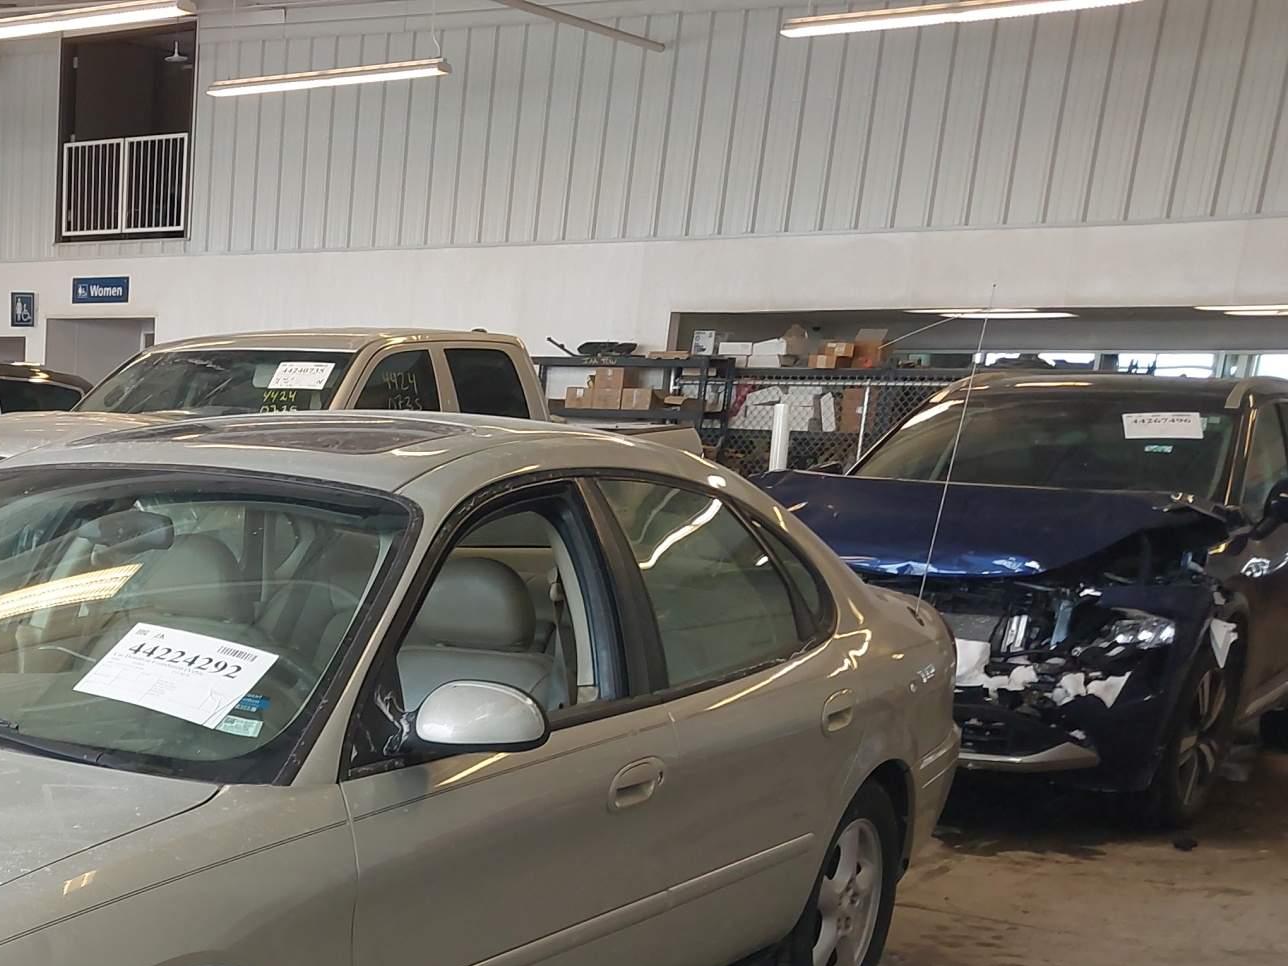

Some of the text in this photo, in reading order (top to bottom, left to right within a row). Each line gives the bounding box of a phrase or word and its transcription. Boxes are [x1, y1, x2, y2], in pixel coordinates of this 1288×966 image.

[89, 284, 123, 297] Women
[263, 390, 297, 402] 4424
[128, 642, 243, 680] 44224292
